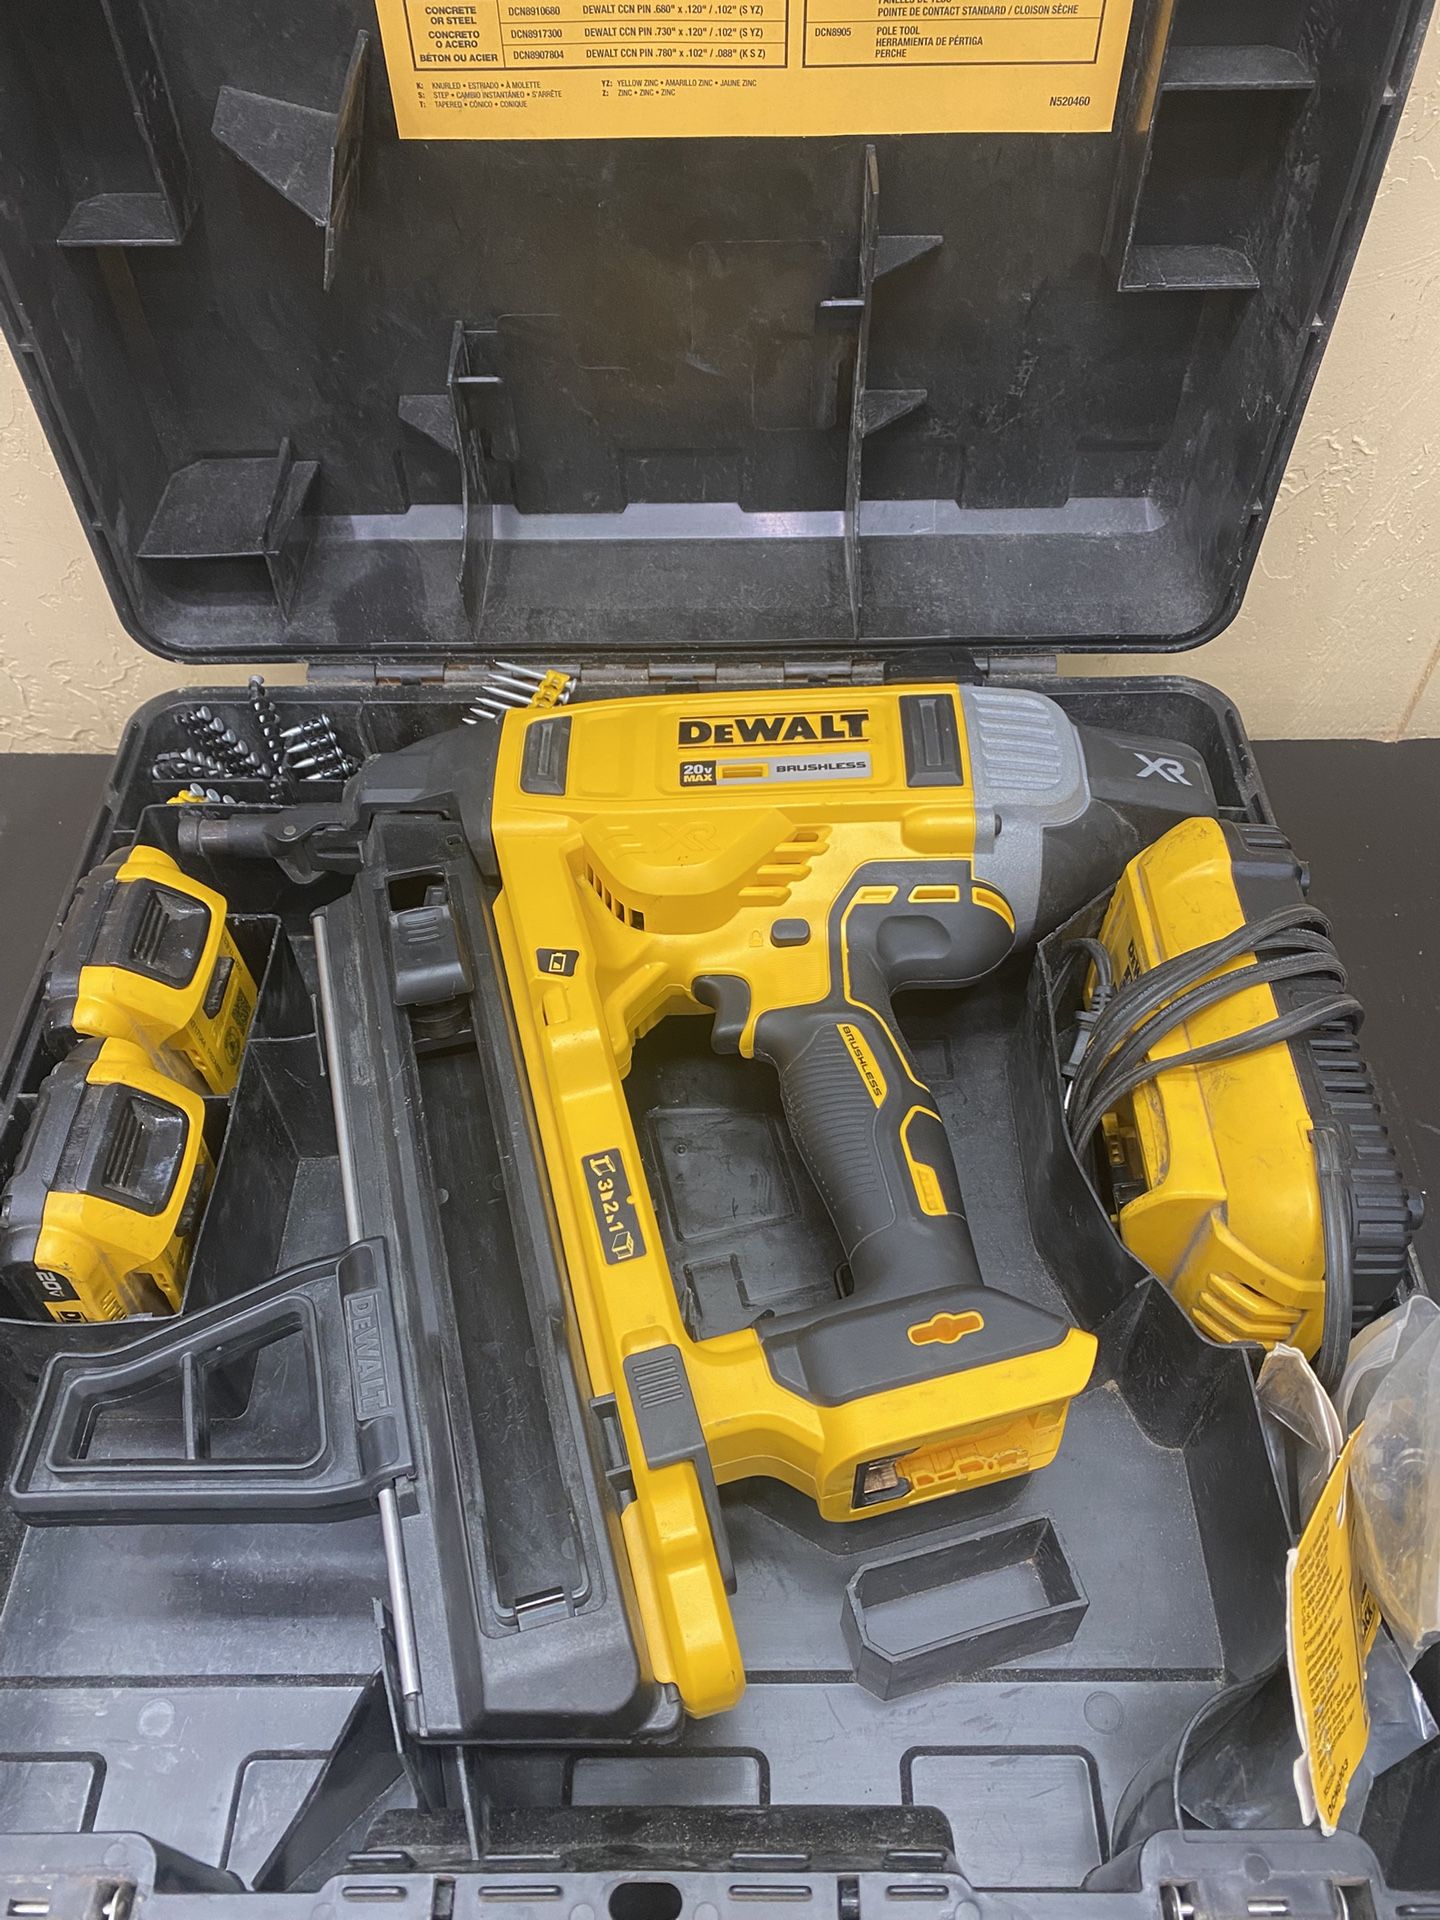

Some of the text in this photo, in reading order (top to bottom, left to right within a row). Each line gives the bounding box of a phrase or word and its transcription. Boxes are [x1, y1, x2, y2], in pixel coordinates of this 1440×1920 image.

[425, 6, 476, 15] CONCRETE
[508, 7, 560, 16] DCN8910680
[583, 5, 616, 14] DEWALT
[618, 4, 635, 14] CCN
[637, 4, 651, 14] PIN
[739, 5, 748, 16] (S
[750, 5, 764, 16] YZ)
[878, 7, 907, 16] POINTE
[909, 7, 920, 16] DE
[922, 6, 960, 16] CONTACT
[962, 6, 1006, 15] STANDARD
[1014, 5, 1050, 15] CLOISON
[1051, 3, 1079, 14] SÈCHE
[430, 16, 477, 25] OR STEEL
[428, 31, 480, 39] CONCRETO
[511, 29, 562, 38] DCN8917300
[584, 27, 617, 37] DEWALT
[619, 27, 636, 36] CCN
[638, 27, 652, 36] PIN
[739, 28, 748, 38] (S
[750, 28, 763, 38] YZ)
[815, 27, 852, 37] DCN8905
[876, 26, 920, 36] POLE TOOL
[445, 40, 478, 48] ACERO
[875, 35, 983, 47] HERRAMIENTA DE PÉRTIGA
[420, 52, 498, 62] BÉTON OU ACIER
[513, 51, 564, 60] DCN8907804
[586, 49, 618, 58] DEWALT
[620, 48, 637, 57] CCN
[639, 48, 653, 57] PIN
[739, 49, 748, 59] (K
[750, 49, 756, 57] S
[757, 49, 766, 59] Z)
[875, 48, 907, 58] PERCHE
[617, 79, 642, 87] YELLOW
[433, 91, 449, 99] STEP
[1050, 96, 1091, 106] N520460
[678, 714, 869, 745] DEWALT
[776, 761, 867, 773] BRUSHLESS
[1133, 752, 1193, 786] XR
[684, 774, 712, 782] MAX
[842, 1026, 882, 1096] BRUSHLESS
[597, 1178, 624, 1232] 3 2 1
[351, 1295, 387, 1414] DEWALT
